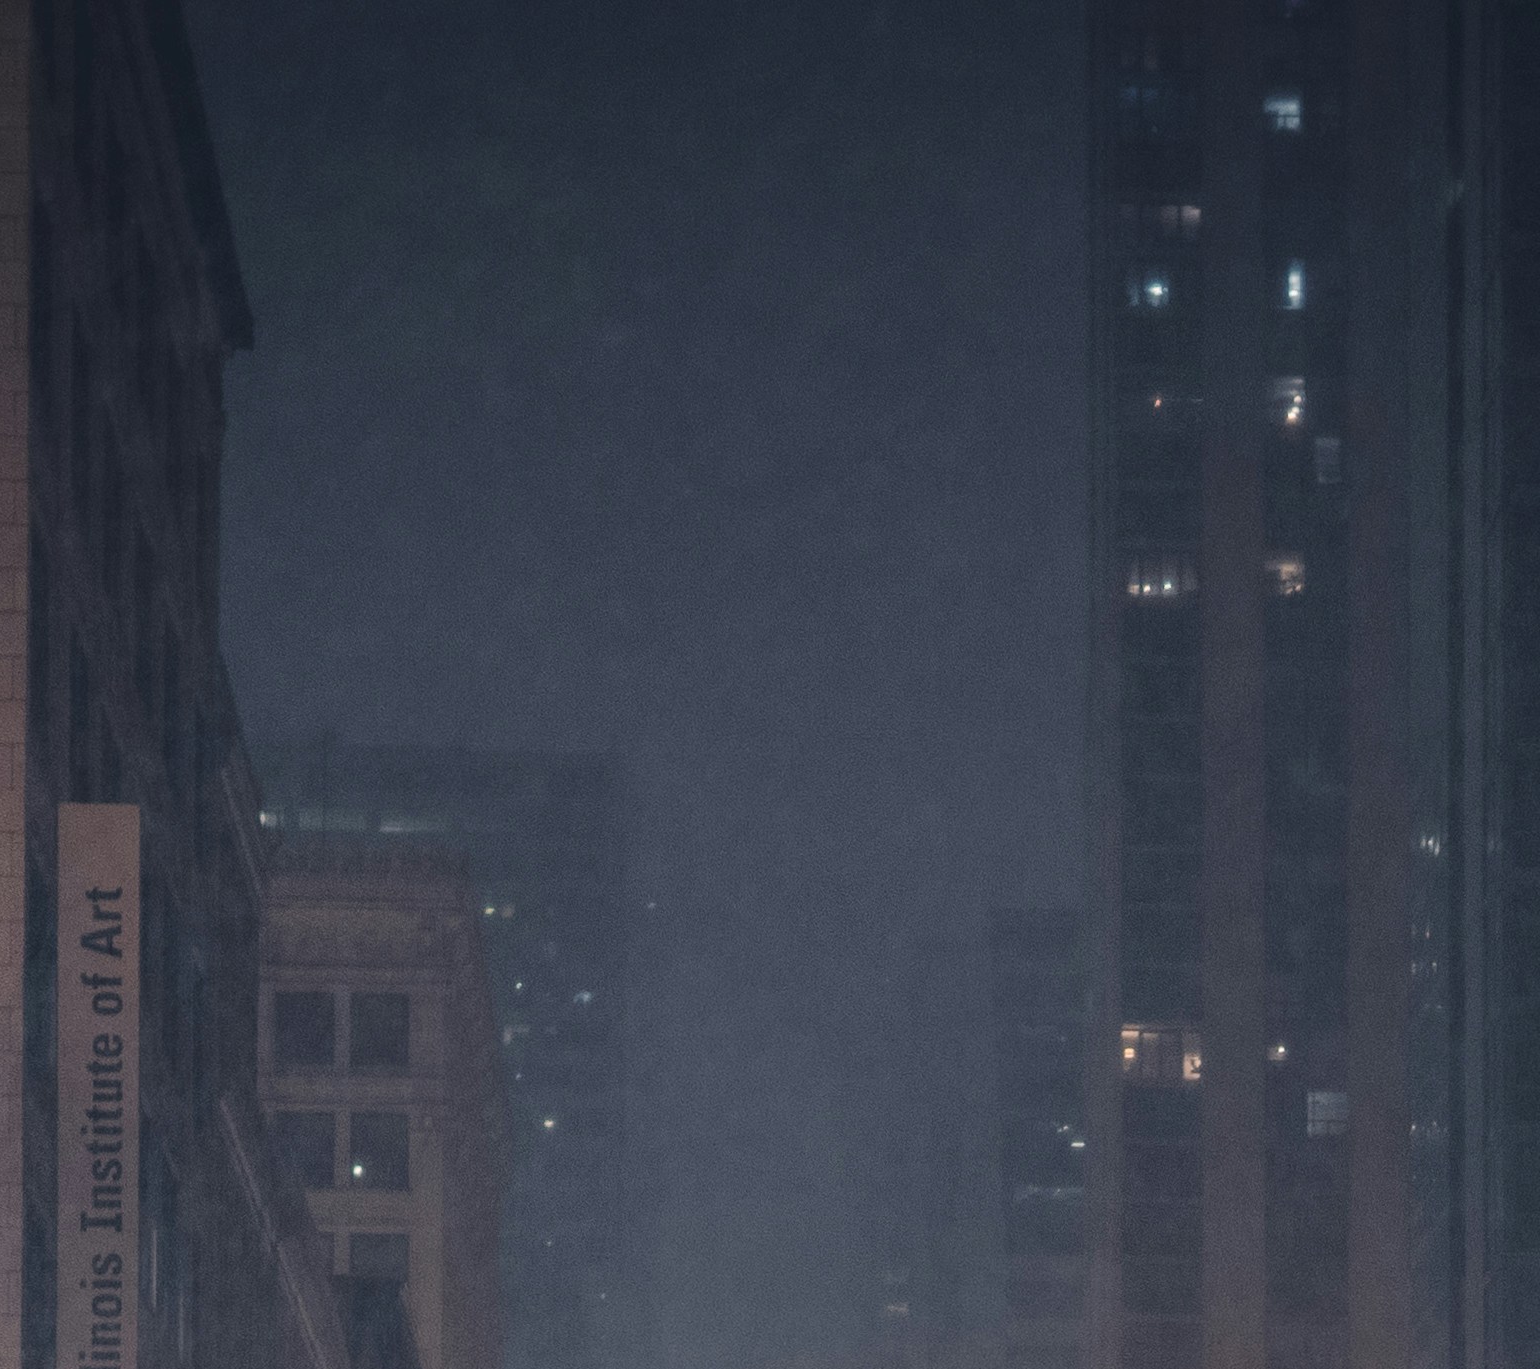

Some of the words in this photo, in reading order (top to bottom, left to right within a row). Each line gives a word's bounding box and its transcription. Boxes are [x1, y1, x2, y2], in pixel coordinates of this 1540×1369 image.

[79, 886, 123, 959] Art
[79, 973, 123, 1017] of
[79, 1032, 124, 1232] Institute
